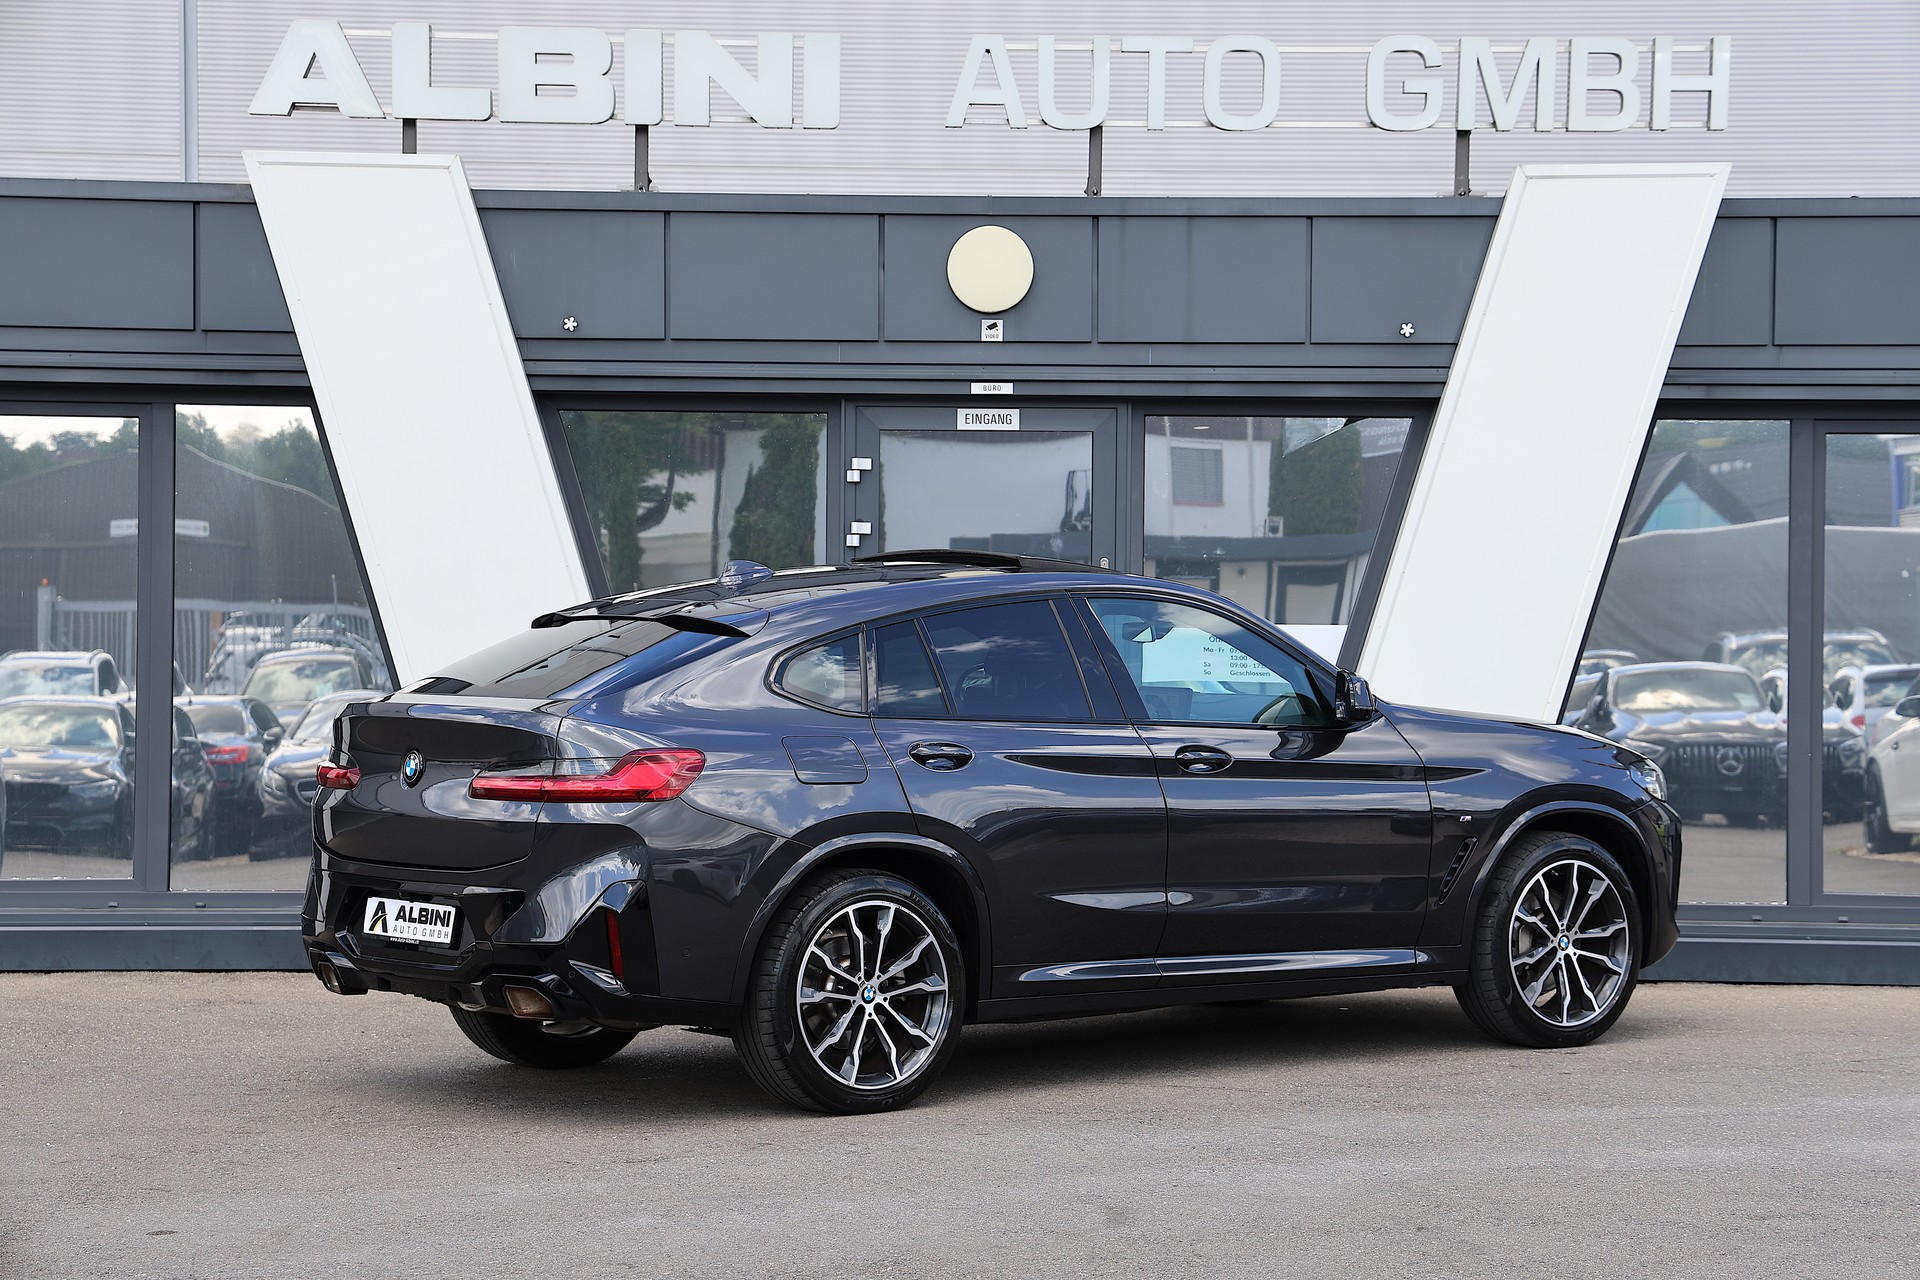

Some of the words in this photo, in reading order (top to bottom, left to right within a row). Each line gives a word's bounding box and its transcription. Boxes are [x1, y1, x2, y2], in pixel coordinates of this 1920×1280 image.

[248, 19, 841, 130] ALBINI
[945, 34, 1282, 131] AUTO
[1365, 34, 1732, 133] GMBH
[965, 413, 1012, 425] EINGANG
[395, 905, 452, 927] ALBINI
[393, 925, 418, 935] AUTO
[422, 928, 449, 939] GMBH
